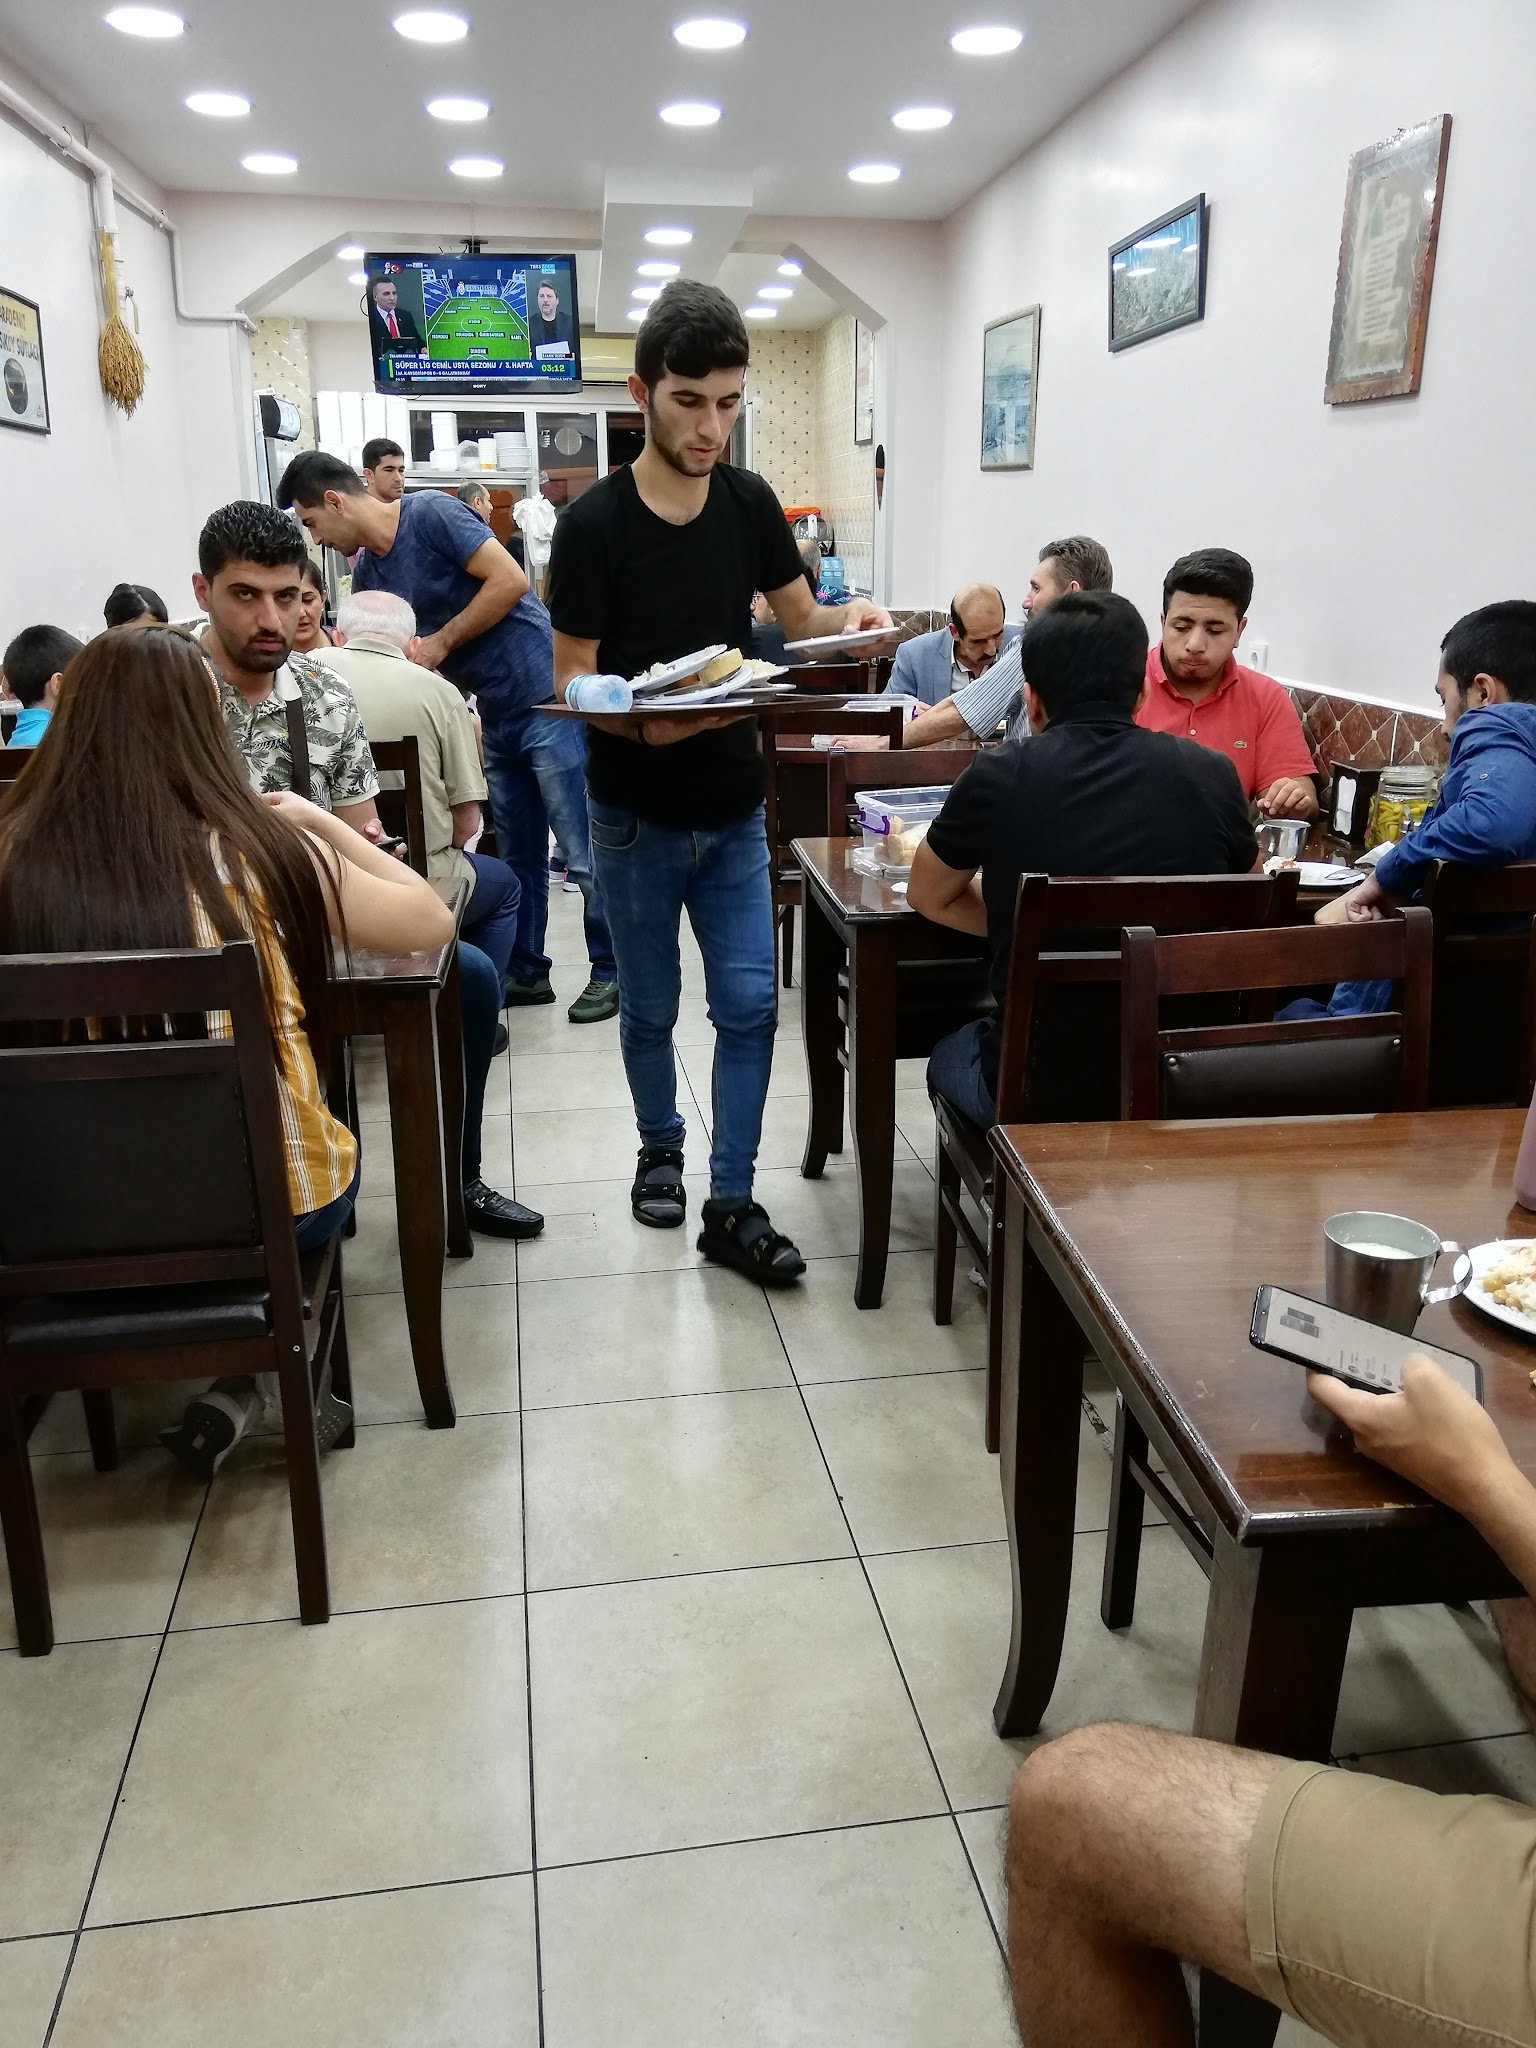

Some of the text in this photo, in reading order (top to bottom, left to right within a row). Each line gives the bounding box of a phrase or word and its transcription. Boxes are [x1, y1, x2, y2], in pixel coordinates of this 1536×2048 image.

[395, 361, 418, 369] SÜPER
[419, 361, 431, 369] LİG
[431, 361, 452, 369] CEMİL
[541, 364, 566, 372] 03:12
